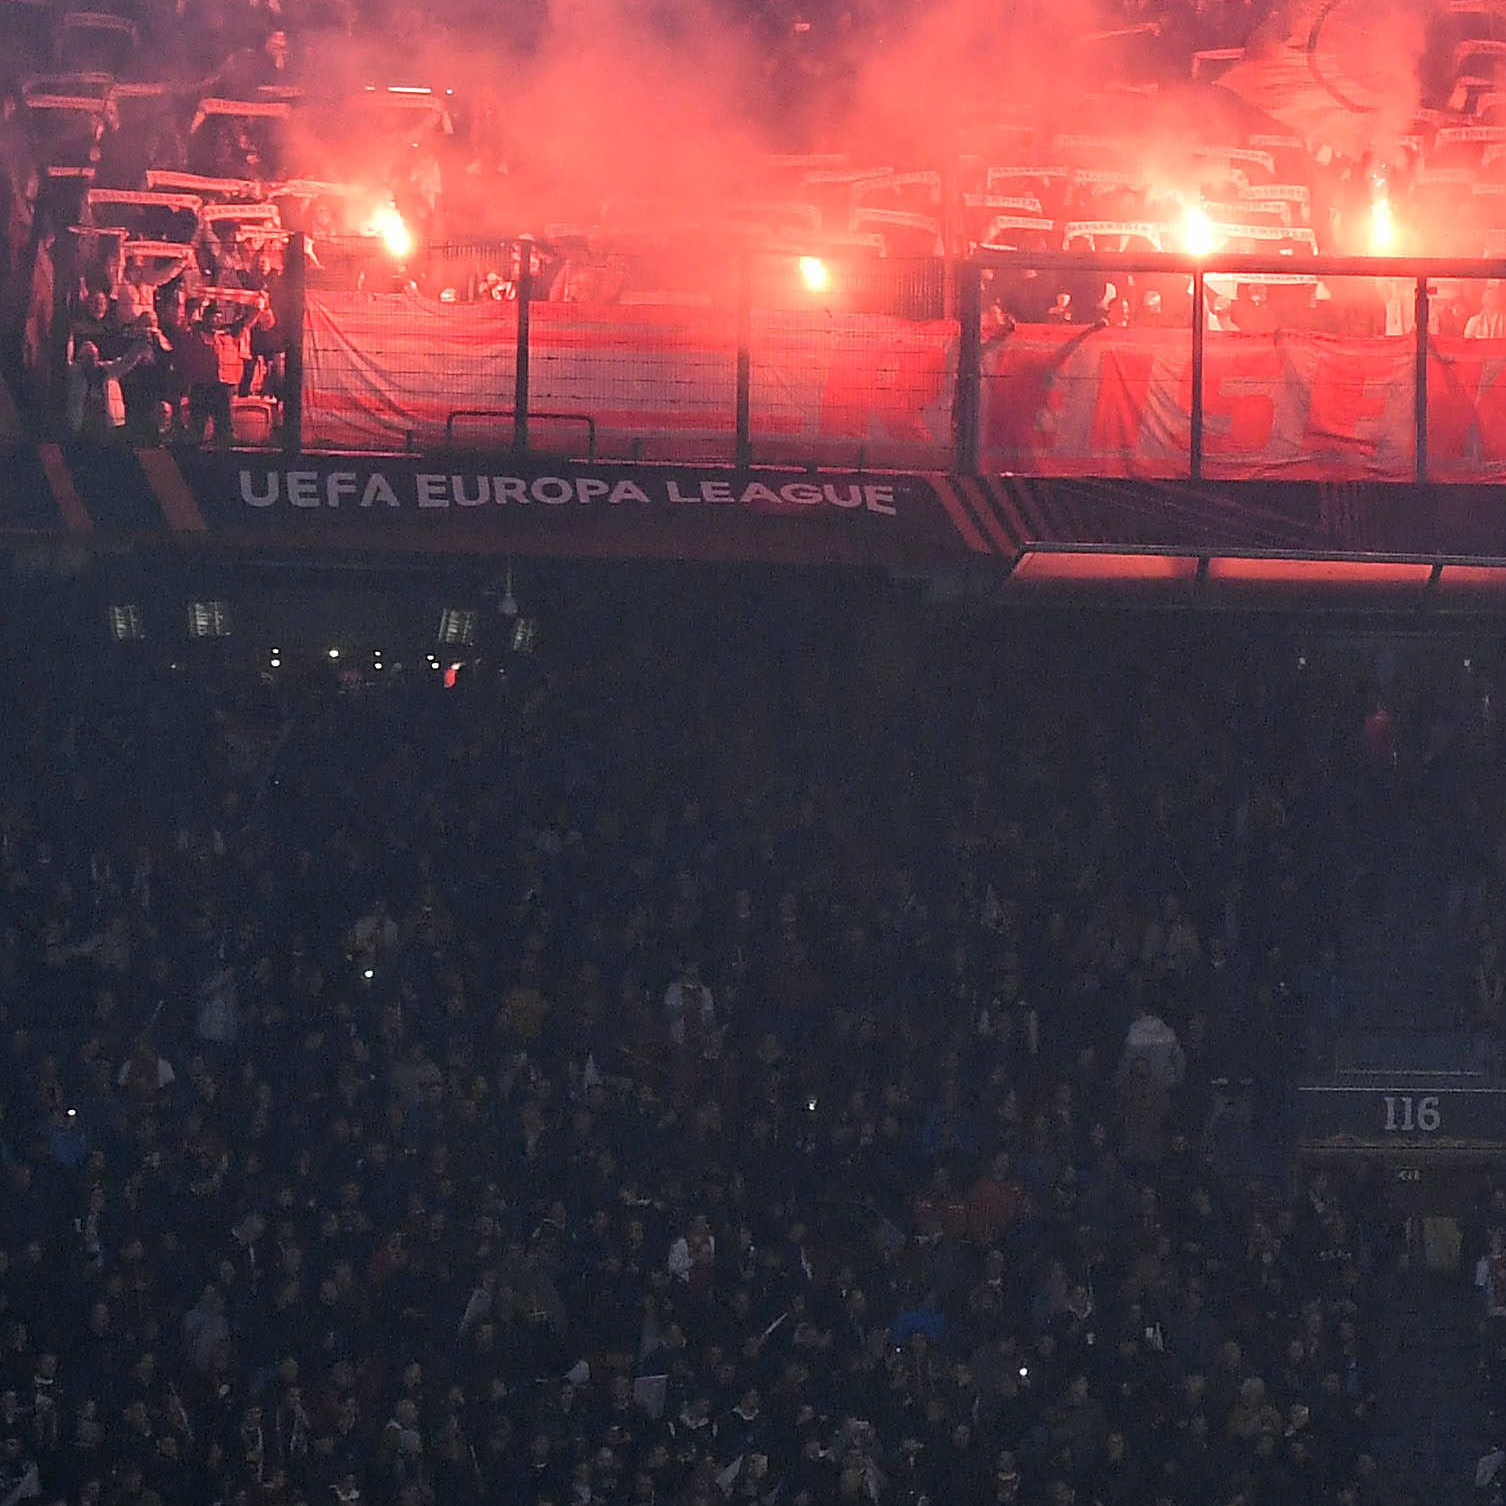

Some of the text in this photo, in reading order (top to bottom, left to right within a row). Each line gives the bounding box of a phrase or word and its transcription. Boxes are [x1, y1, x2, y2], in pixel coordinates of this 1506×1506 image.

[238, 470, 897, 515] UEFA EUROPA LEAGUE
[1383, 1096, 1441, 1131] 116
